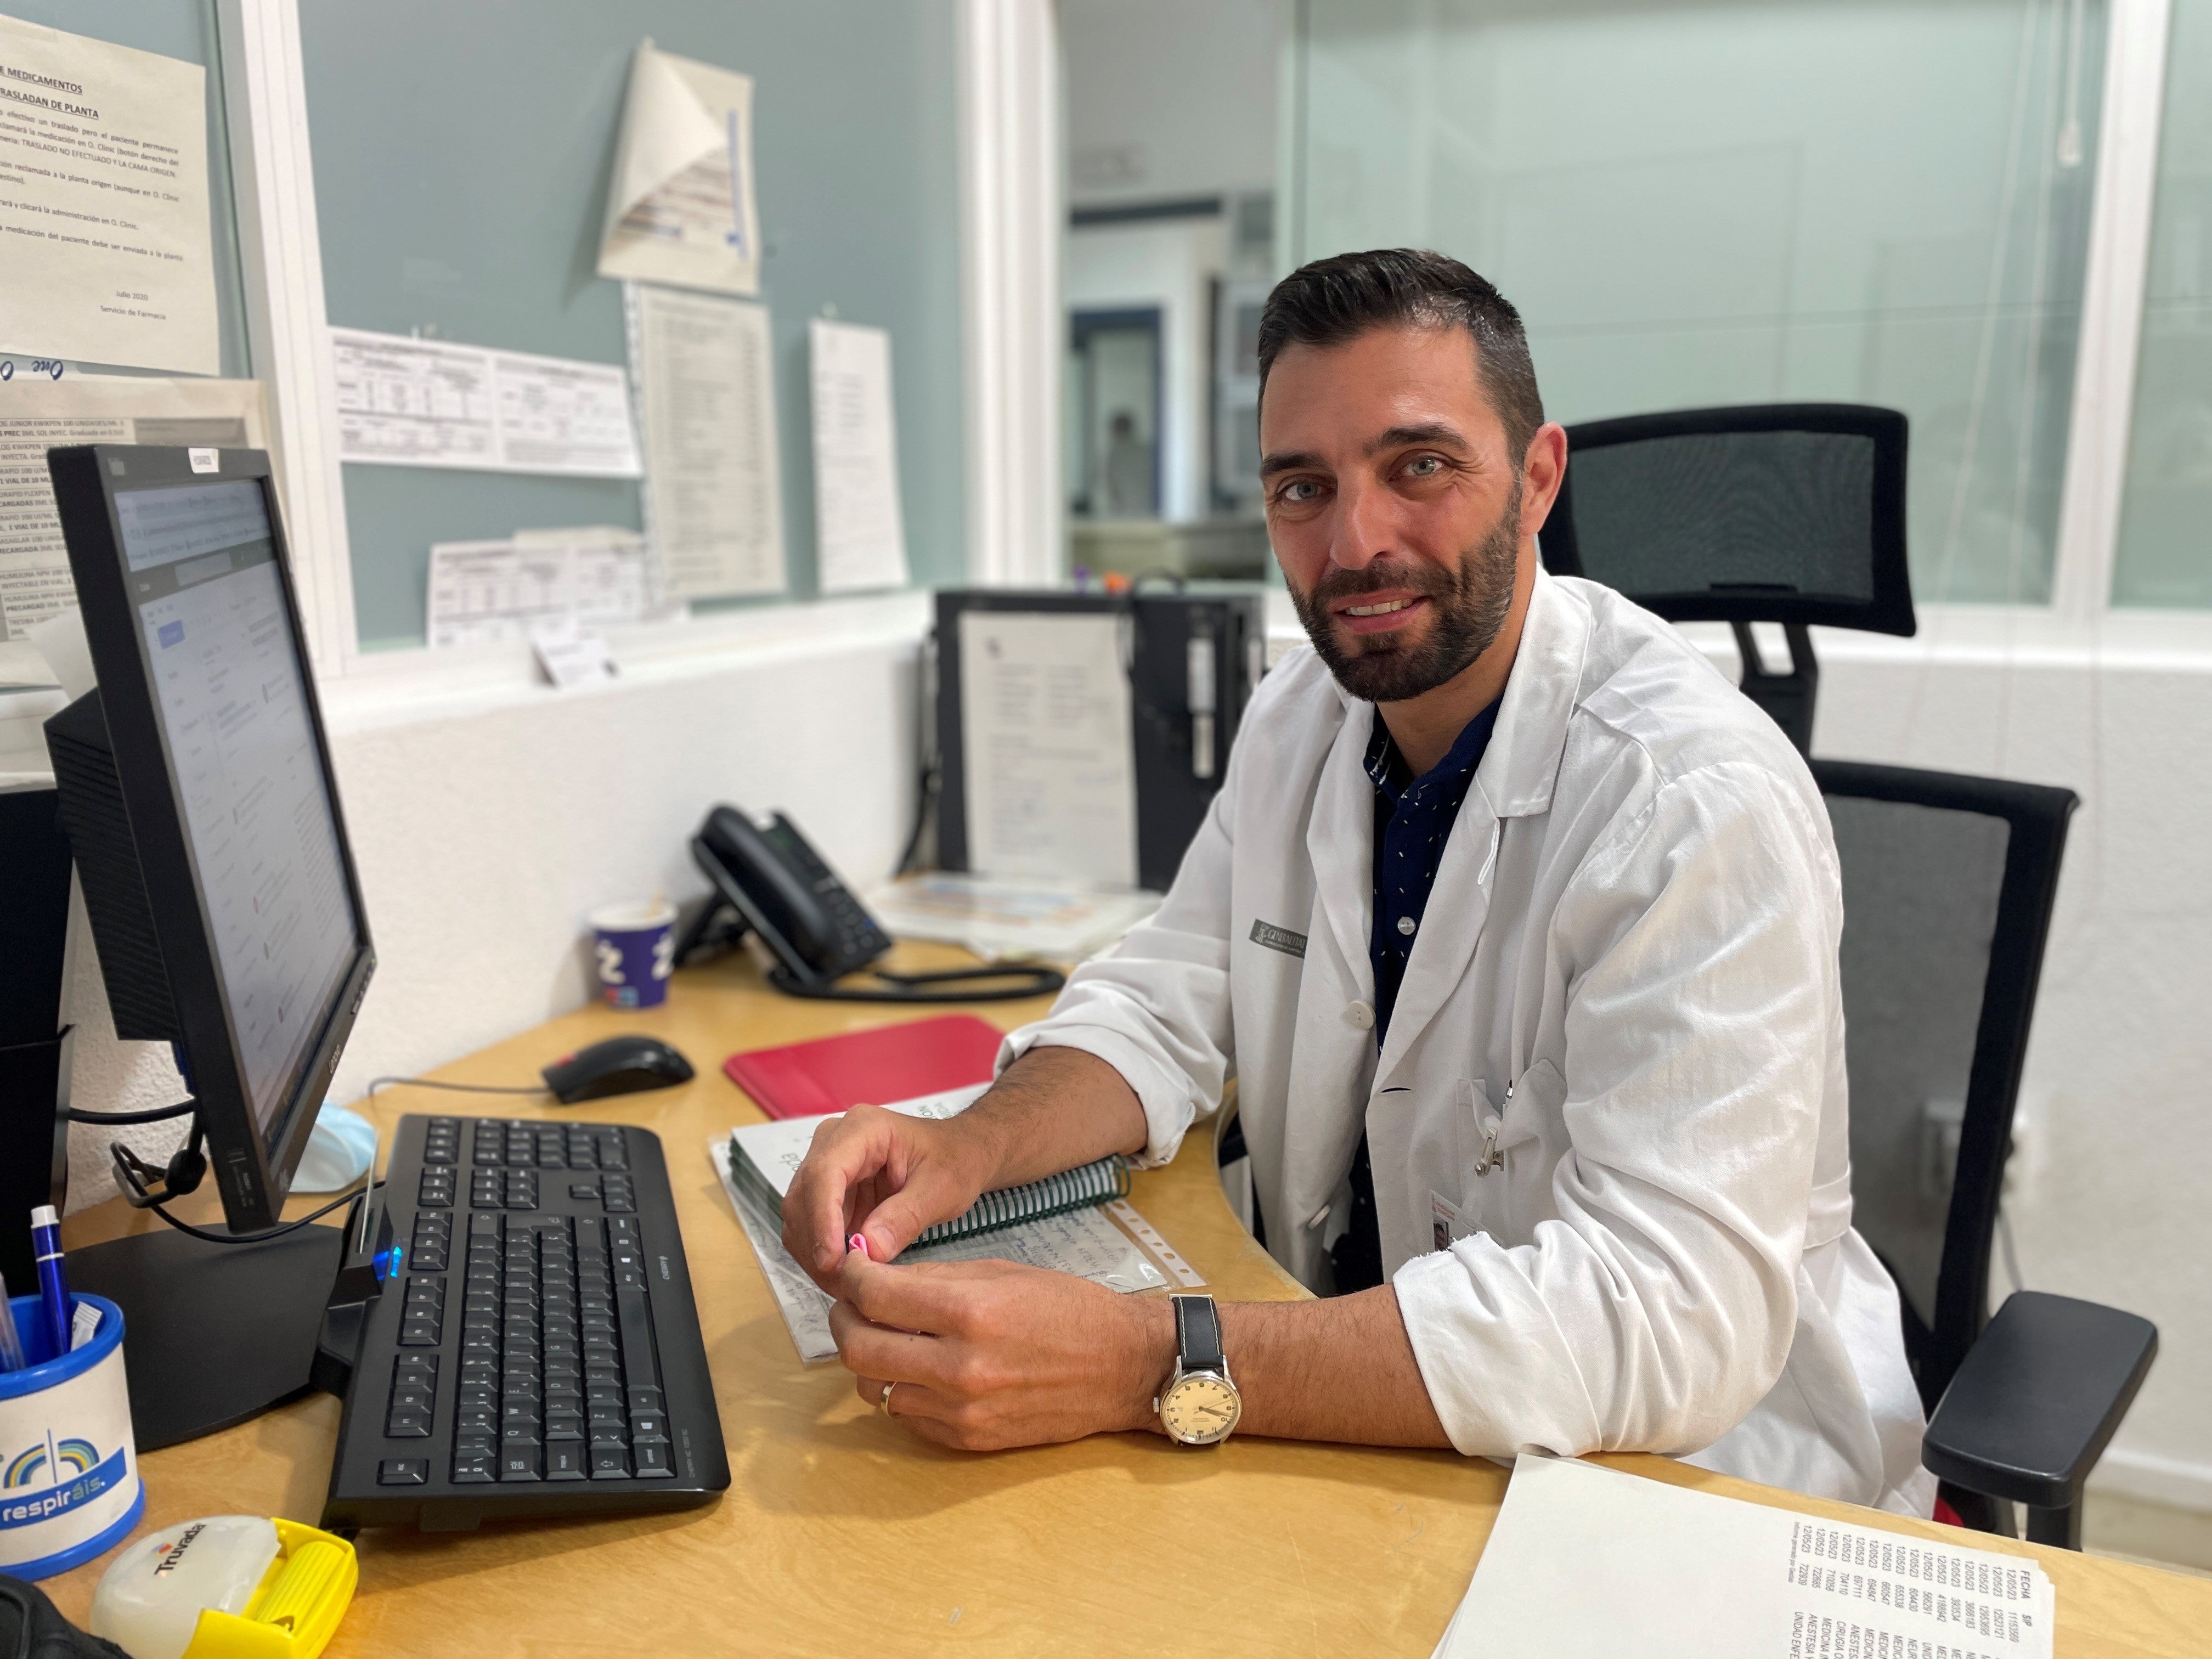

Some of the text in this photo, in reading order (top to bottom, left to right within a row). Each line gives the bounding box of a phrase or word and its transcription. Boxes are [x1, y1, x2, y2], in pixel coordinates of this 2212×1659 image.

[7, 67, 82, 93] MEDICAMENTOS
[0, 87, 99, 119] RASLADAN DE PLANTA
[37, 132, 75, 144] medicación
[98, 144, 115, 153] Clinic
[141, 153, 167, 163] derecho
[52, 121, 78, 132] traslado
[82, 128, 97, 137] pero
[111, 136, 139, 146] paciente
[143, 142, 178, 154] permanece
[22, 139, 58, 153] TRASLADO
[59, 147, 70, 155] NO
[72, 150, 111, 164] EFECTUADO
[128, 162, 148, 172] CAMA
[15, 164, 50, 177] reclamada
[68, 174, 89, 184] planta
[91, 180, 111, 189] origen
[114, 183, 140, 195] (aunque
[163, 193, 179, 202] Clinic
[20, 203, 42, 212] clicará
[52, 208, 100, 223] administración
[5, 225, 45, 238] medicación
[48, 232, 58, 240] del
[61, 235, 89, 245] paciente
[92, 239, 108, 248] debe
[123, 245, 147, 255] enviada
[164, 253, 183, 261] planta
[116, 290, 148, 301] Julio 2020
[100, 305, 126, 315] Servicio
[138, 310, 166, 320] Farmacia
[32, 360, 63, 381] One
[1, 581, 38, 589] INYECTABLE
[154, 1523, 207, 1575] Truvada
[1802, 1525, 1812, 1554] 12/05/23
[1815, 1528, 1825, 1557] 12/05/23
[1828, 1531, 1838, 1560] 12/05/23
[1842, 1534, 1852, 1563] 12/05/23
[1855, 1537, 1865, 1566] 12/05/23
[1869, 1540, 1878, 1568] 12/05/23
[1882, 1543, 1892, 1572] 12/05/23
[1896, 1545, 1906, 1575] 12/05/23
[1910, 1548, 1919, 1578] 12/05/23
[1923, 1551, 1933, 1581] 12/05/23
[1938, 1555, 1946, 1584] 12/05/23
[1951, 1558, 1961, 1588] 12/05/23
[1965, 1560, 1974, 1591] 12/05/23
[1979, 1564, 1989, 1594] 12/05/23
[1993, 1565, 2003, 1598] 12/05/23
[2007, 1568, 2017, 1601] 12/05/23
[2021, 1570, 2032, 1627] FECHA SIP
[1792, 1611, 1804, 1638] UNIDAD
[1805, 1613, 1818, 1655] ANESTESIA
[1820, 1617, 1832, 1653] MEDICINA
[1835, 1621, 1846, 1652] CIRUGIA
